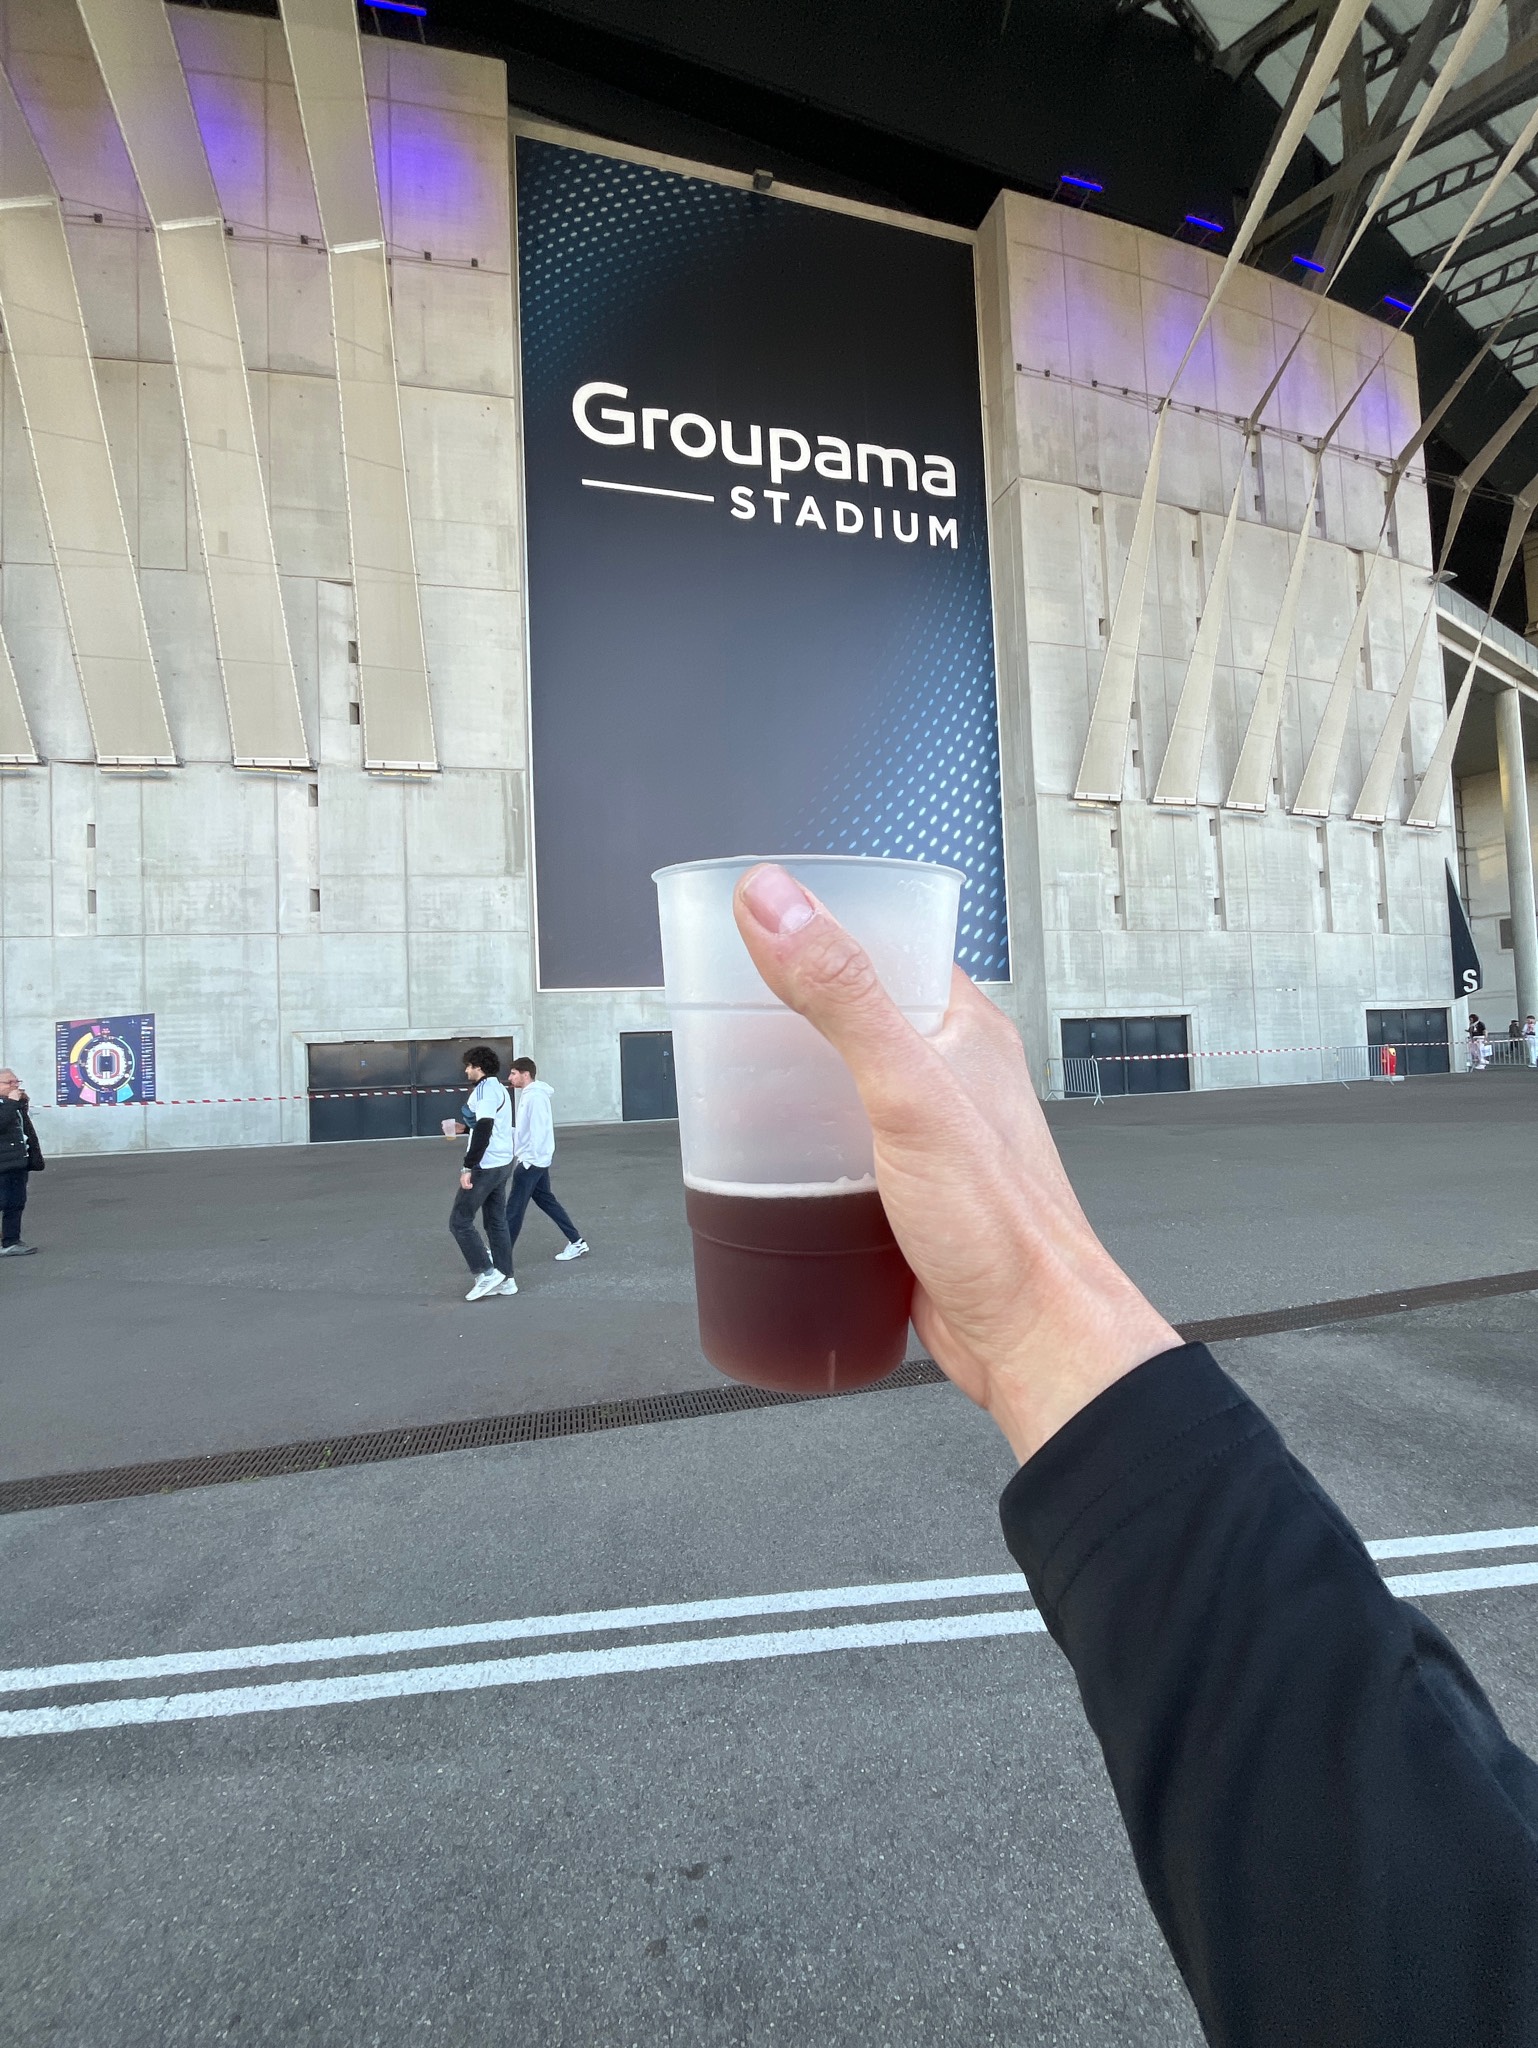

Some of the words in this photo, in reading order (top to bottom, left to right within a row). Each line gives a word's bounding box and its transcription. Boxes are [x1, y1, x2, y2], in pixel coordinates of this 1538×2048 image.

[572, 381, 957, 497] Groupama
[730, 485, 959, 550] STADIUM
[1462, 968, 1478, 993] S
